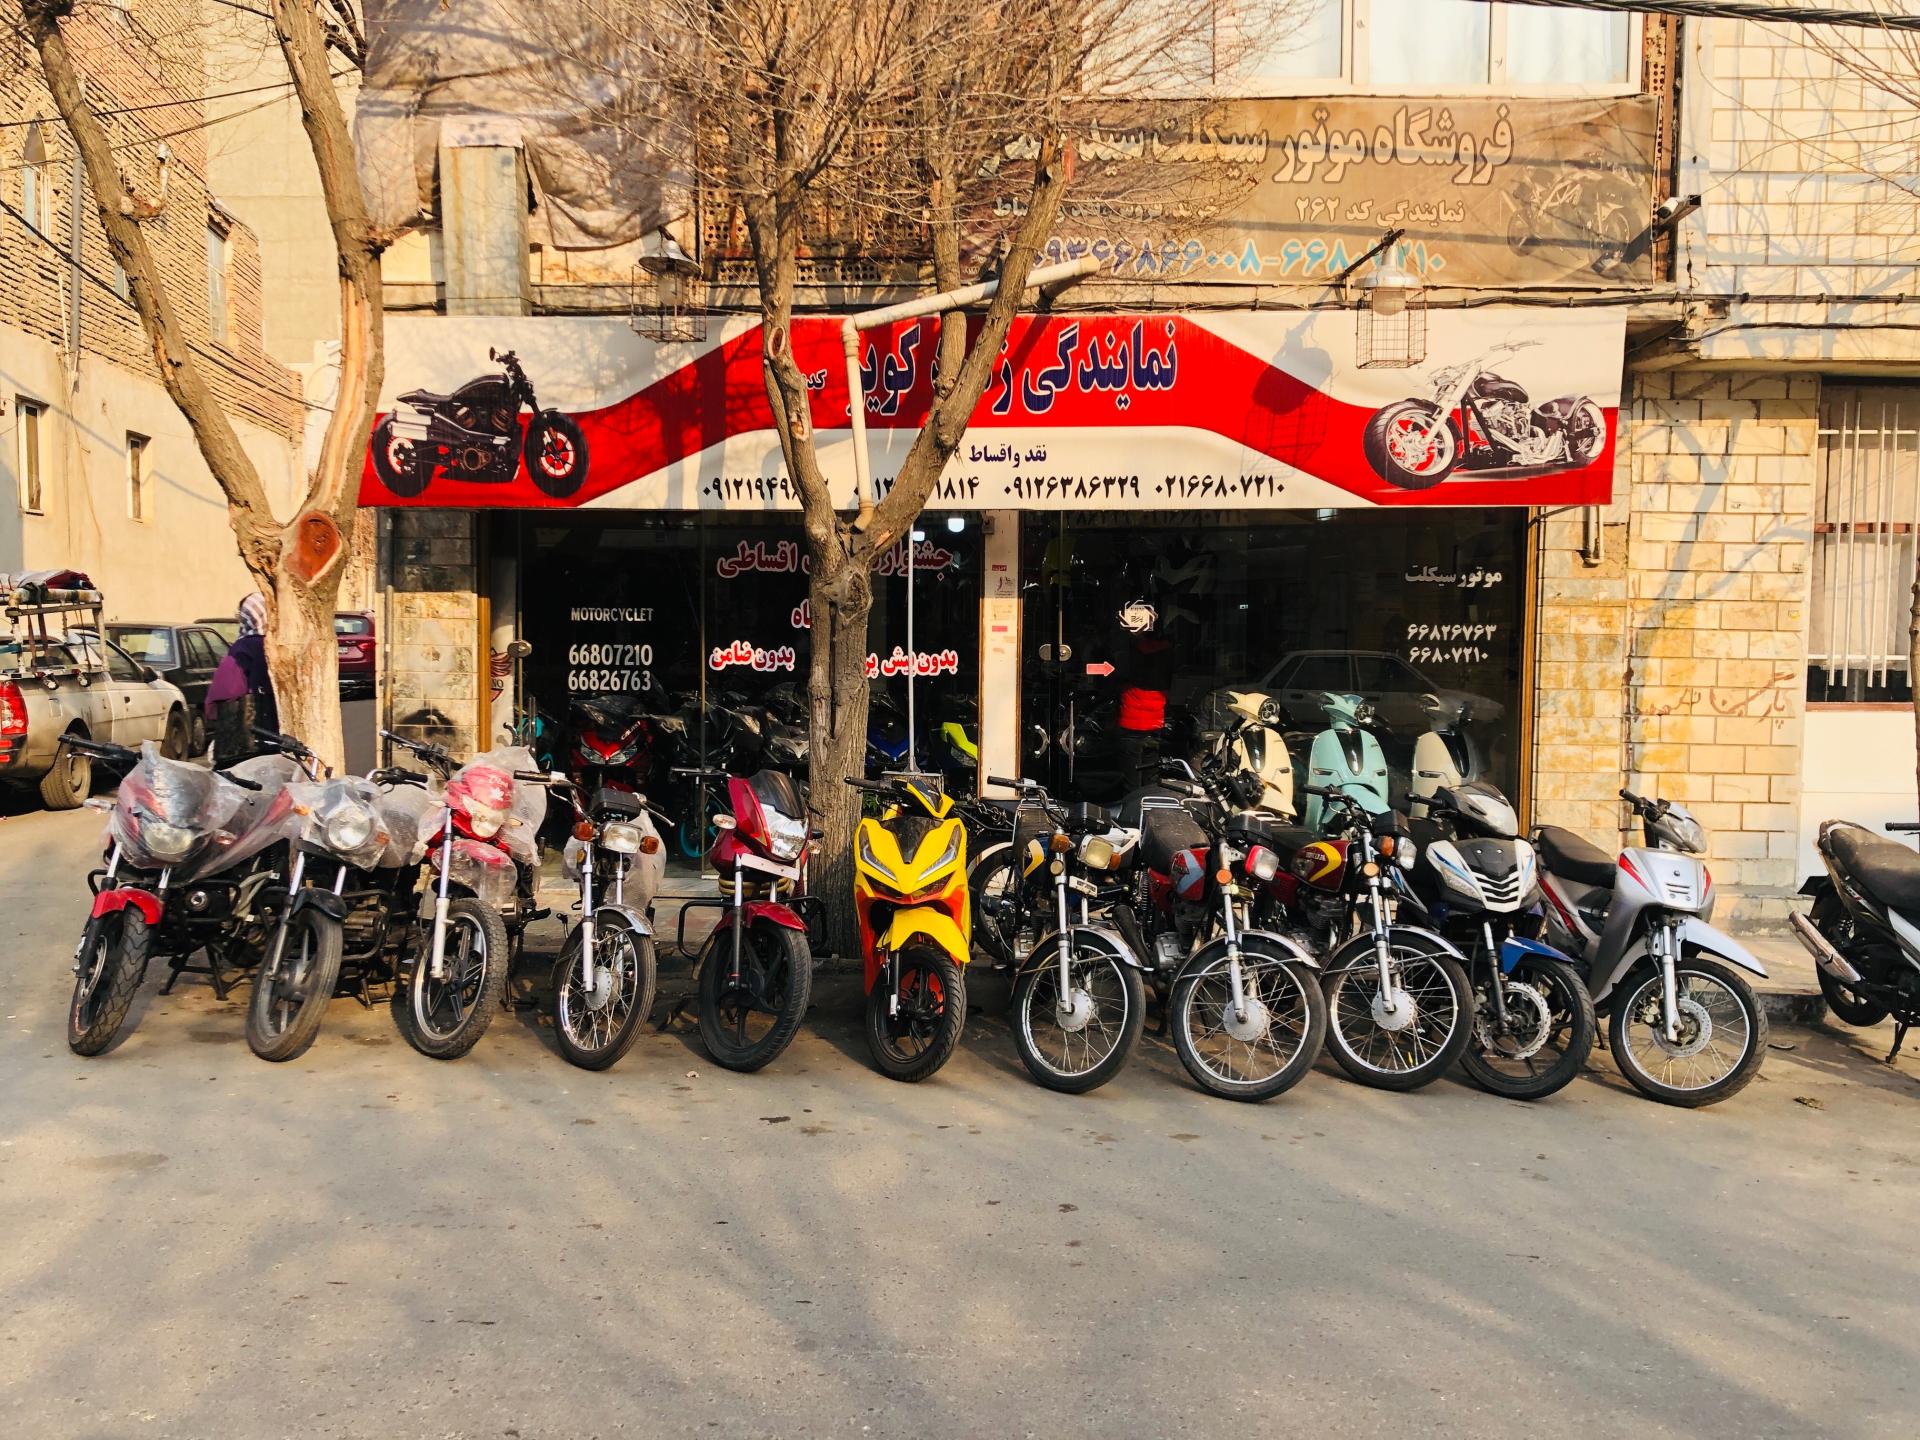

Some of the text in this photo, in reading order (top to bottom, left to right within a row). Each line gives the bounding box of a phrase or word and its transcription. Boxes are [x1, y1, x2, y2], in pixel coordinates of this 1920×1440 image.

[1272, 106, 1368, 184] موتور
[1372, 103, 1515, 185] فروشگاه
[1295, 197, 1465, 227] نمایندگی کد ۲۶۲
[847, 322, 921, 416] کوی
[1022, 319, 1178, 415] نمایندگی
[1024, 443, 1048, 463] نقد
[1004, 474, 1140, 500] ۰۹۱۲۶۳۸۶۳۲۹
[1155, 474, 1286, 499] ۰۲۱۶۶۸۰۷۲۱۰
[717, 539, 798, 578] اقساطی
[1404, 564, 1504, 588] موتور سیکلت
[571, 607, 654, 622] MOTORCYCLET
[1406, 623, 1497, 641] ۶۶۸۲۶۷۶۳
[568, 643, 654, 666] 66807210
[709, 640, 754, 671] ضامن
[752, 646, 796, 672] بدون
[880, 646, 916, 678] پیش
[915, 649, 959, 677] بدون
[1408, 646, 1489, 664] ۶۶۸۰۷۲۱۰
[567, 669, 652, 691] 66826763
